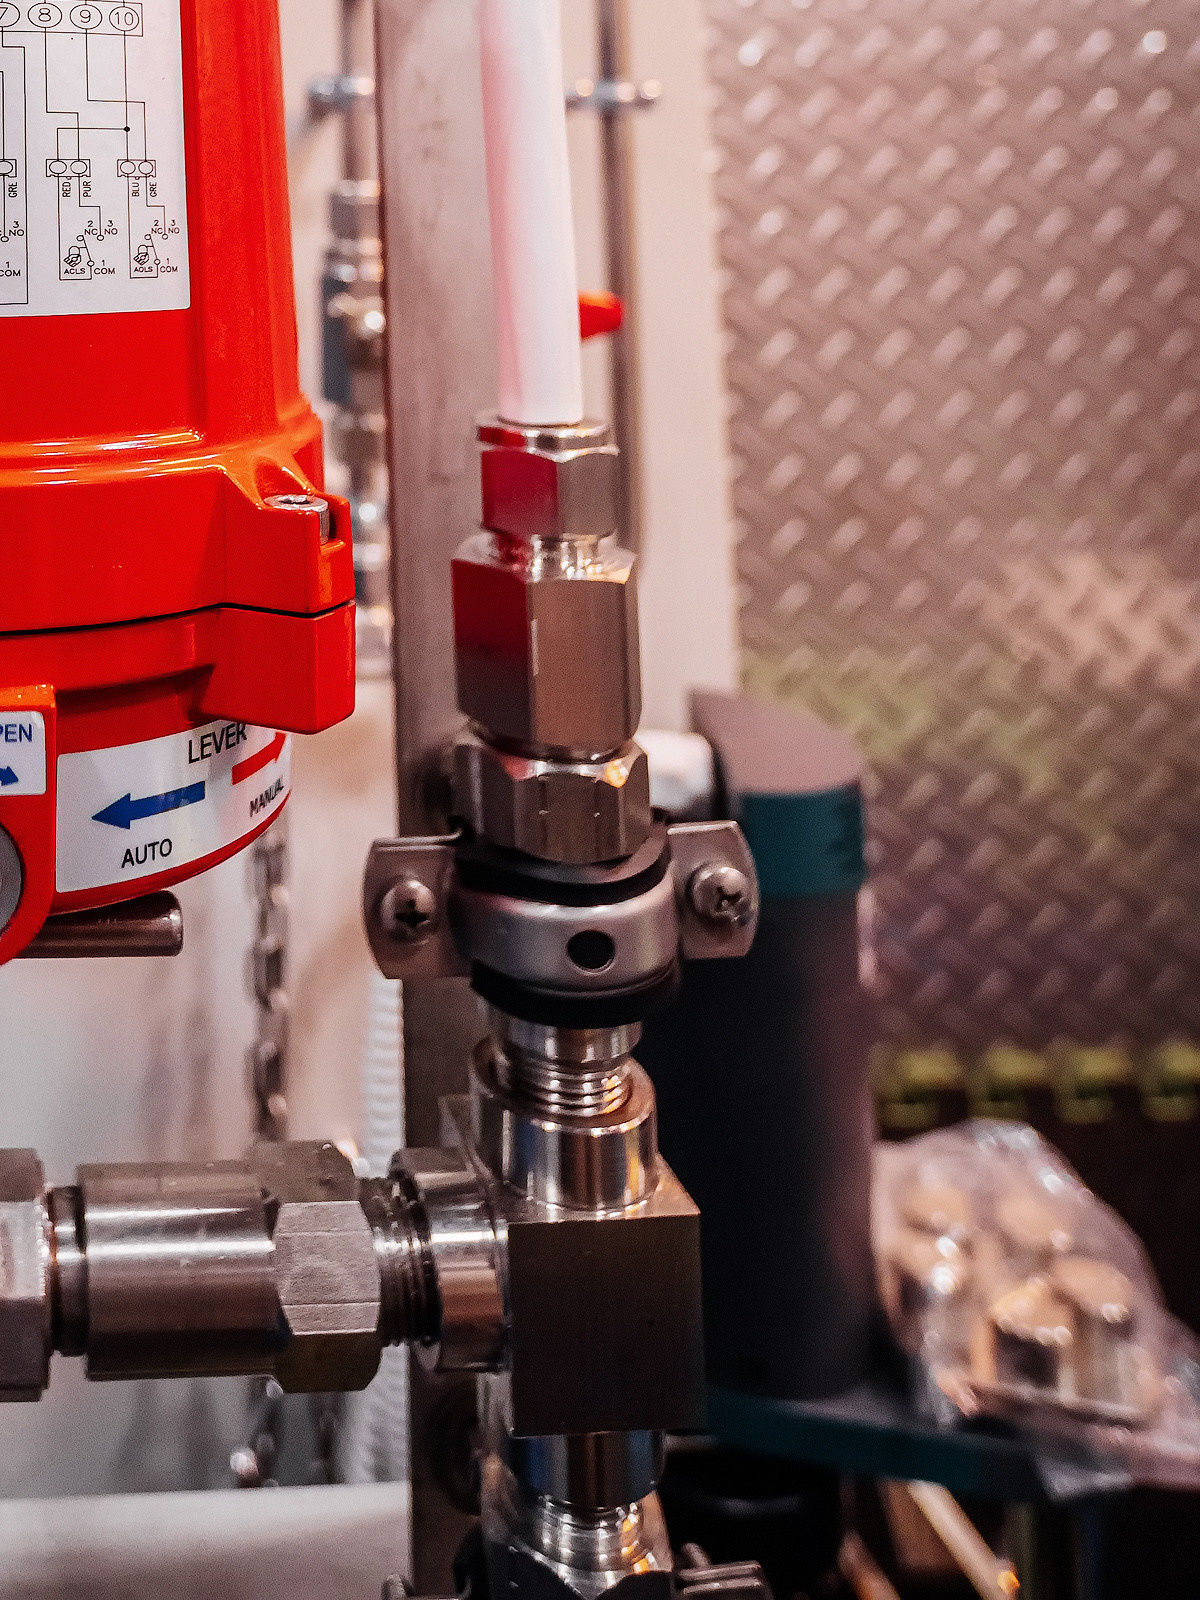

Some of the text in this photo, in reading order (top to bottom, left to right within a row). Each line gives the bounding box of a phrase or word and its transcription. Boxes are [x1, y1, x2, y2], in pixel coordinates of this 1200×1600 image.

[38, 7, 51, 22] 8
[80, 9, 91, 23] 9
[114, 11, 134, 26] 10
[8, 182, 17, 198] GRE
[62, 182, 71, 197] RED
[83, 181, 92, 197] PUR
[132, 182, 140, 197] BLU
[149, 182, 157, 197] GRE
[9, 229, 25, 237] NO
[104, 228, 118, 236] NO
[188, 722, 247, 764] LEVER
[250, 775, 284, 818] MANUAL
[121, 838, 173, 869] AUTO
